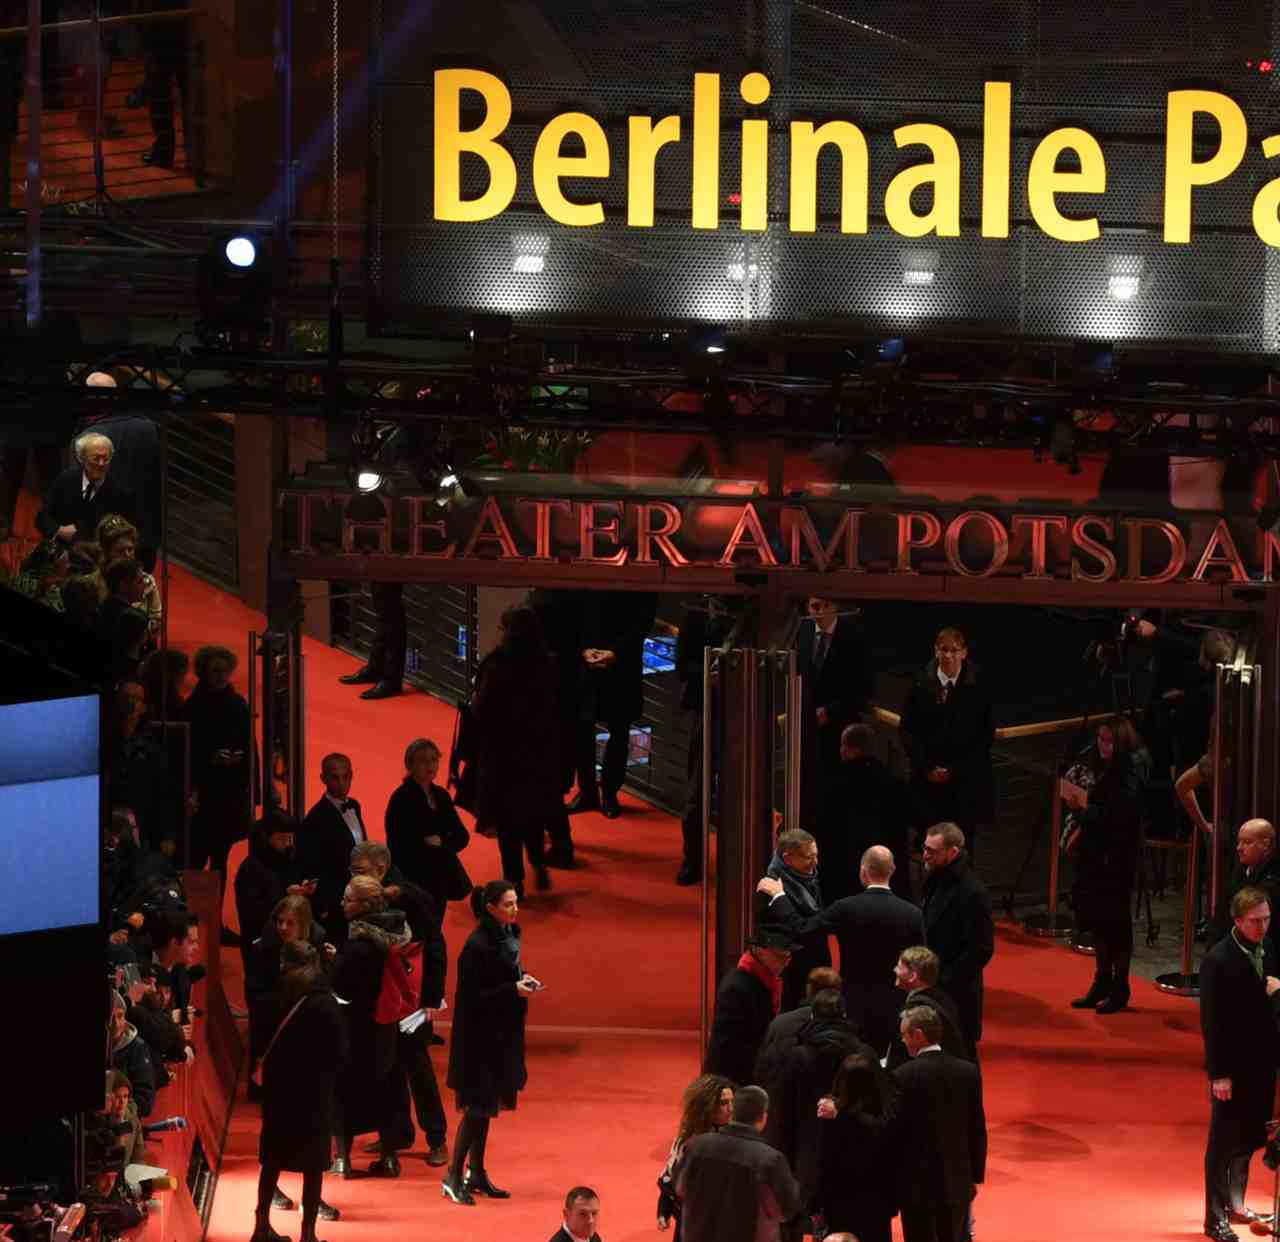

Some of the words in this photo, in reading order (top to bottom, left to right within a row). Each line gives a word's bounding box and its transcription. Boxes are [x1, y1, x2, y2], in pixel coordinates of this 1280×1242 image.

[433, 68, 1107, 243] Berlinale
[280, 488, 690, 568] THEATER
[715, 500, 866, 576] AM
